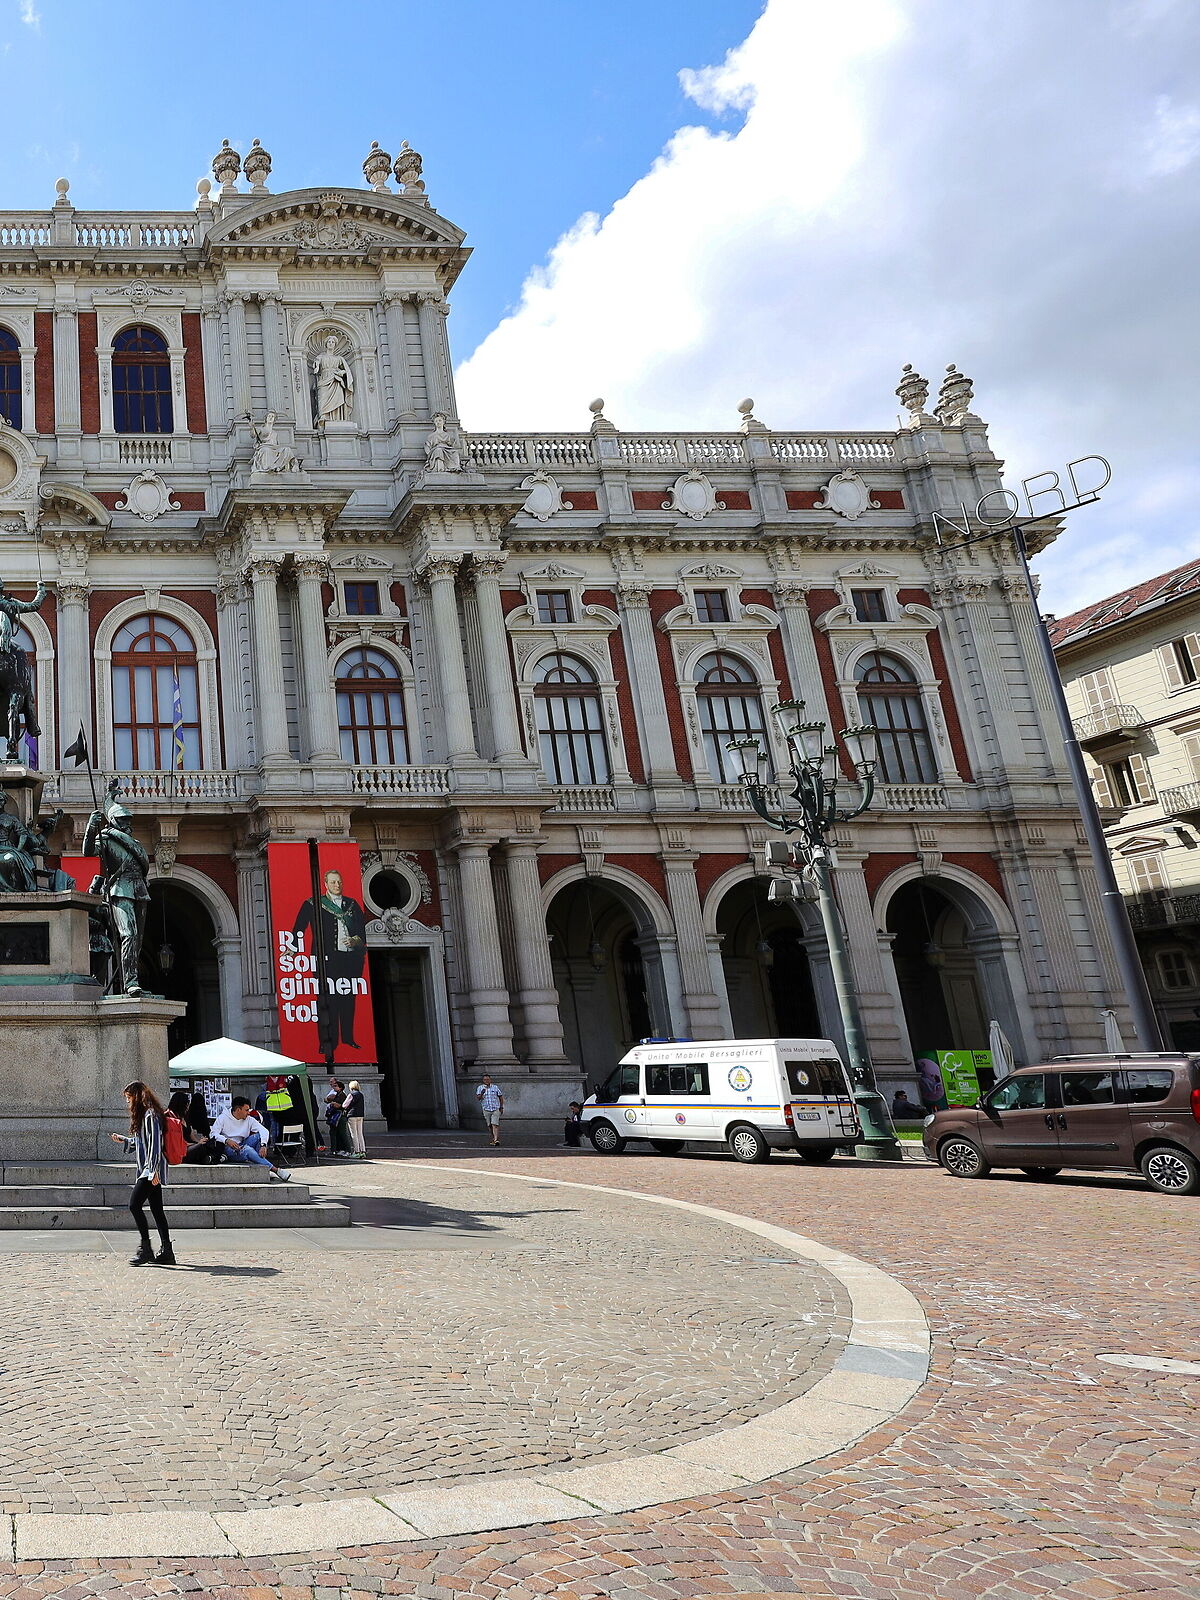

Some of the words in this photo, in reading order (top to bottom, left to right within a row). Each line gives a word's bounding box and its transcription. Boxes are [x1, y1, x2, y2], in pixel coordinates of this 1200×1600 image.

[931, 454, 1112, 546] NORD
[278, 930, 305, 953] Ri
[282, 1000, 319, 1023] to!
[675, 1052, 705, 1060] Mobile
[709, 1048, 763, 1058] Bersaglieri
